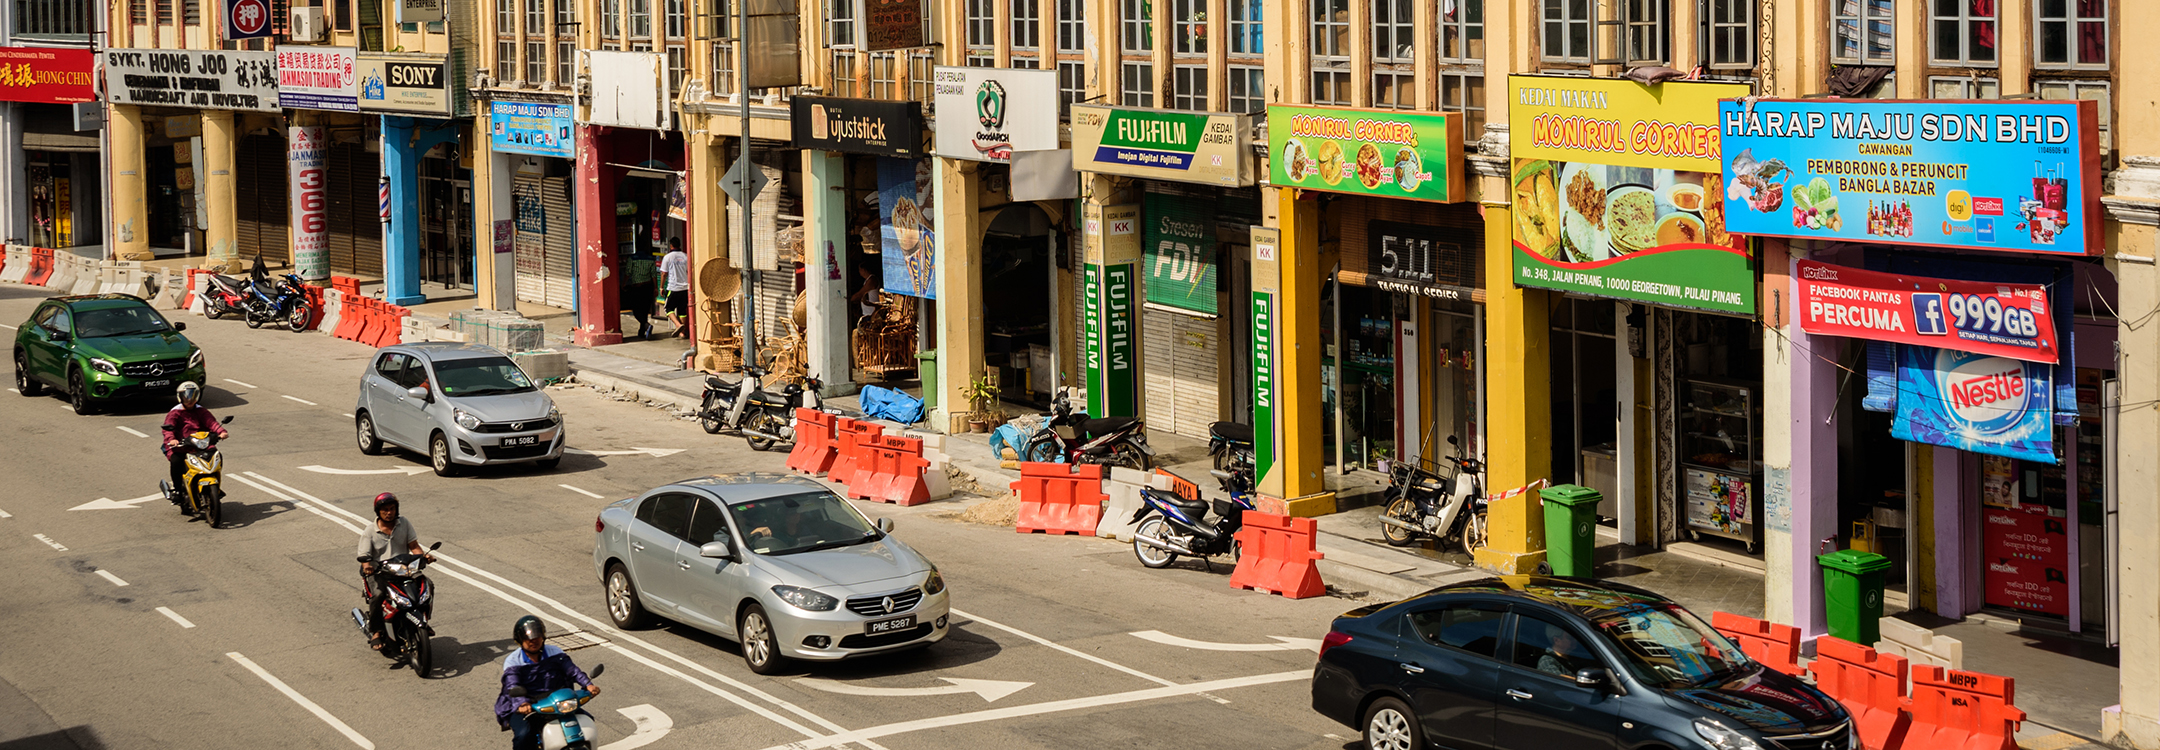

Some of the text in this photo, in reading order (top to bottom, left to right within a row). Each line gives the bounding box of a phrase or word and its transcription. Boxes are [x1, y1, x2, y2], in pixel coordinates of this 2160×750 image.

[238, 4, 259, 27] 押
[109, 52, 146, 68] SYKT.
[148, 53, 190, 74] HONG
[197, 54, 227, 75] JOO
[36, 70, 92, 86] HONG CHIN
[172, 76, 178, 90] &
[280, 70, 312, 88] JANMASOO
[313, 72, 342, 89] TRADING
[392, 65, 436, 86] SONY
[190, 92, 208, 106] AND
[1520, 88, 1608, 110] KEDAI MAKAN
[494, 104, 570, 118] HARAP MAJU SDN BHD
[830, 114, 886, 143] ujuststick
[1118, 118, 1188, 145] FUJIFILM
[1211, 122, 1232, 134] KEDAI
[1292, 114, 1413, 145] MONIRUL CORNER
[1726, 111, 2070, 144] HARAP MAJU SDN BHD
[1203, 134, 1234, 145] GAMBAR
[1532, 113, 1720, 160] MONIRUL CORNER
[1858, 142, 1913, 156] CAWANGAN
[1118, 151, 1182, 166] Imejan Digital Fujifilm
[1211, 154, 1222, 166] KK
[1305, 158, 1316, 166] Nasi
[1341, 162, 1356, 171] Curry
[1379, 166, 1394, 175] Curry
[1414, 172, 1432, 181] Capati
[1806, 160, 1968, 180] PEMBORONG & PERUNCIT
[1379, 174, 1394, 183] Ayam
[1839, 178, 1936, 196] BANGLA BAZAR
[300, 168, 326, 234] 366
[1950, 203, 1964, 214] digi
[1088, 222, 1097, 232] KK
[1114, 222, 1130, 232] KK
[1953, 225, 1974, 234] mobile
[1260, 248, 1271, 258] KK
[1381, 235, 1433, 283] 5.11
[1522, 266, 1744, 305] No. 348, JALAN PENANG, 10000 GEORGETOWN, PULAU PINANG.
[2014, 288, 2028, 297] No.1
[1810, 284, 1902, 304] FACEBOOK PANTAS
[1086, 270, 1098, 369] FUJIFILM
[1110, 270, 1128, 371] FUJIFILM
[1810, 302, 1906, 332] PERCUMA
[1949, 294, 2038, 337] 999GB
[1256, 298, 1269, 408] FUJIFILM
[1951, 368, 2024, 410] Nestlé
[518, 436, 534, 444] 5082
[886, 438, 906, 448] MBPP
[1172, 480, 1192, 500] HAYA
[2024, 534, 2037, 542] IDD
[2025, 582, 2038, 590] IDD
[872, 618, 910, 632] PME 5287
[1950, 672, 1978, 688] MBPP
